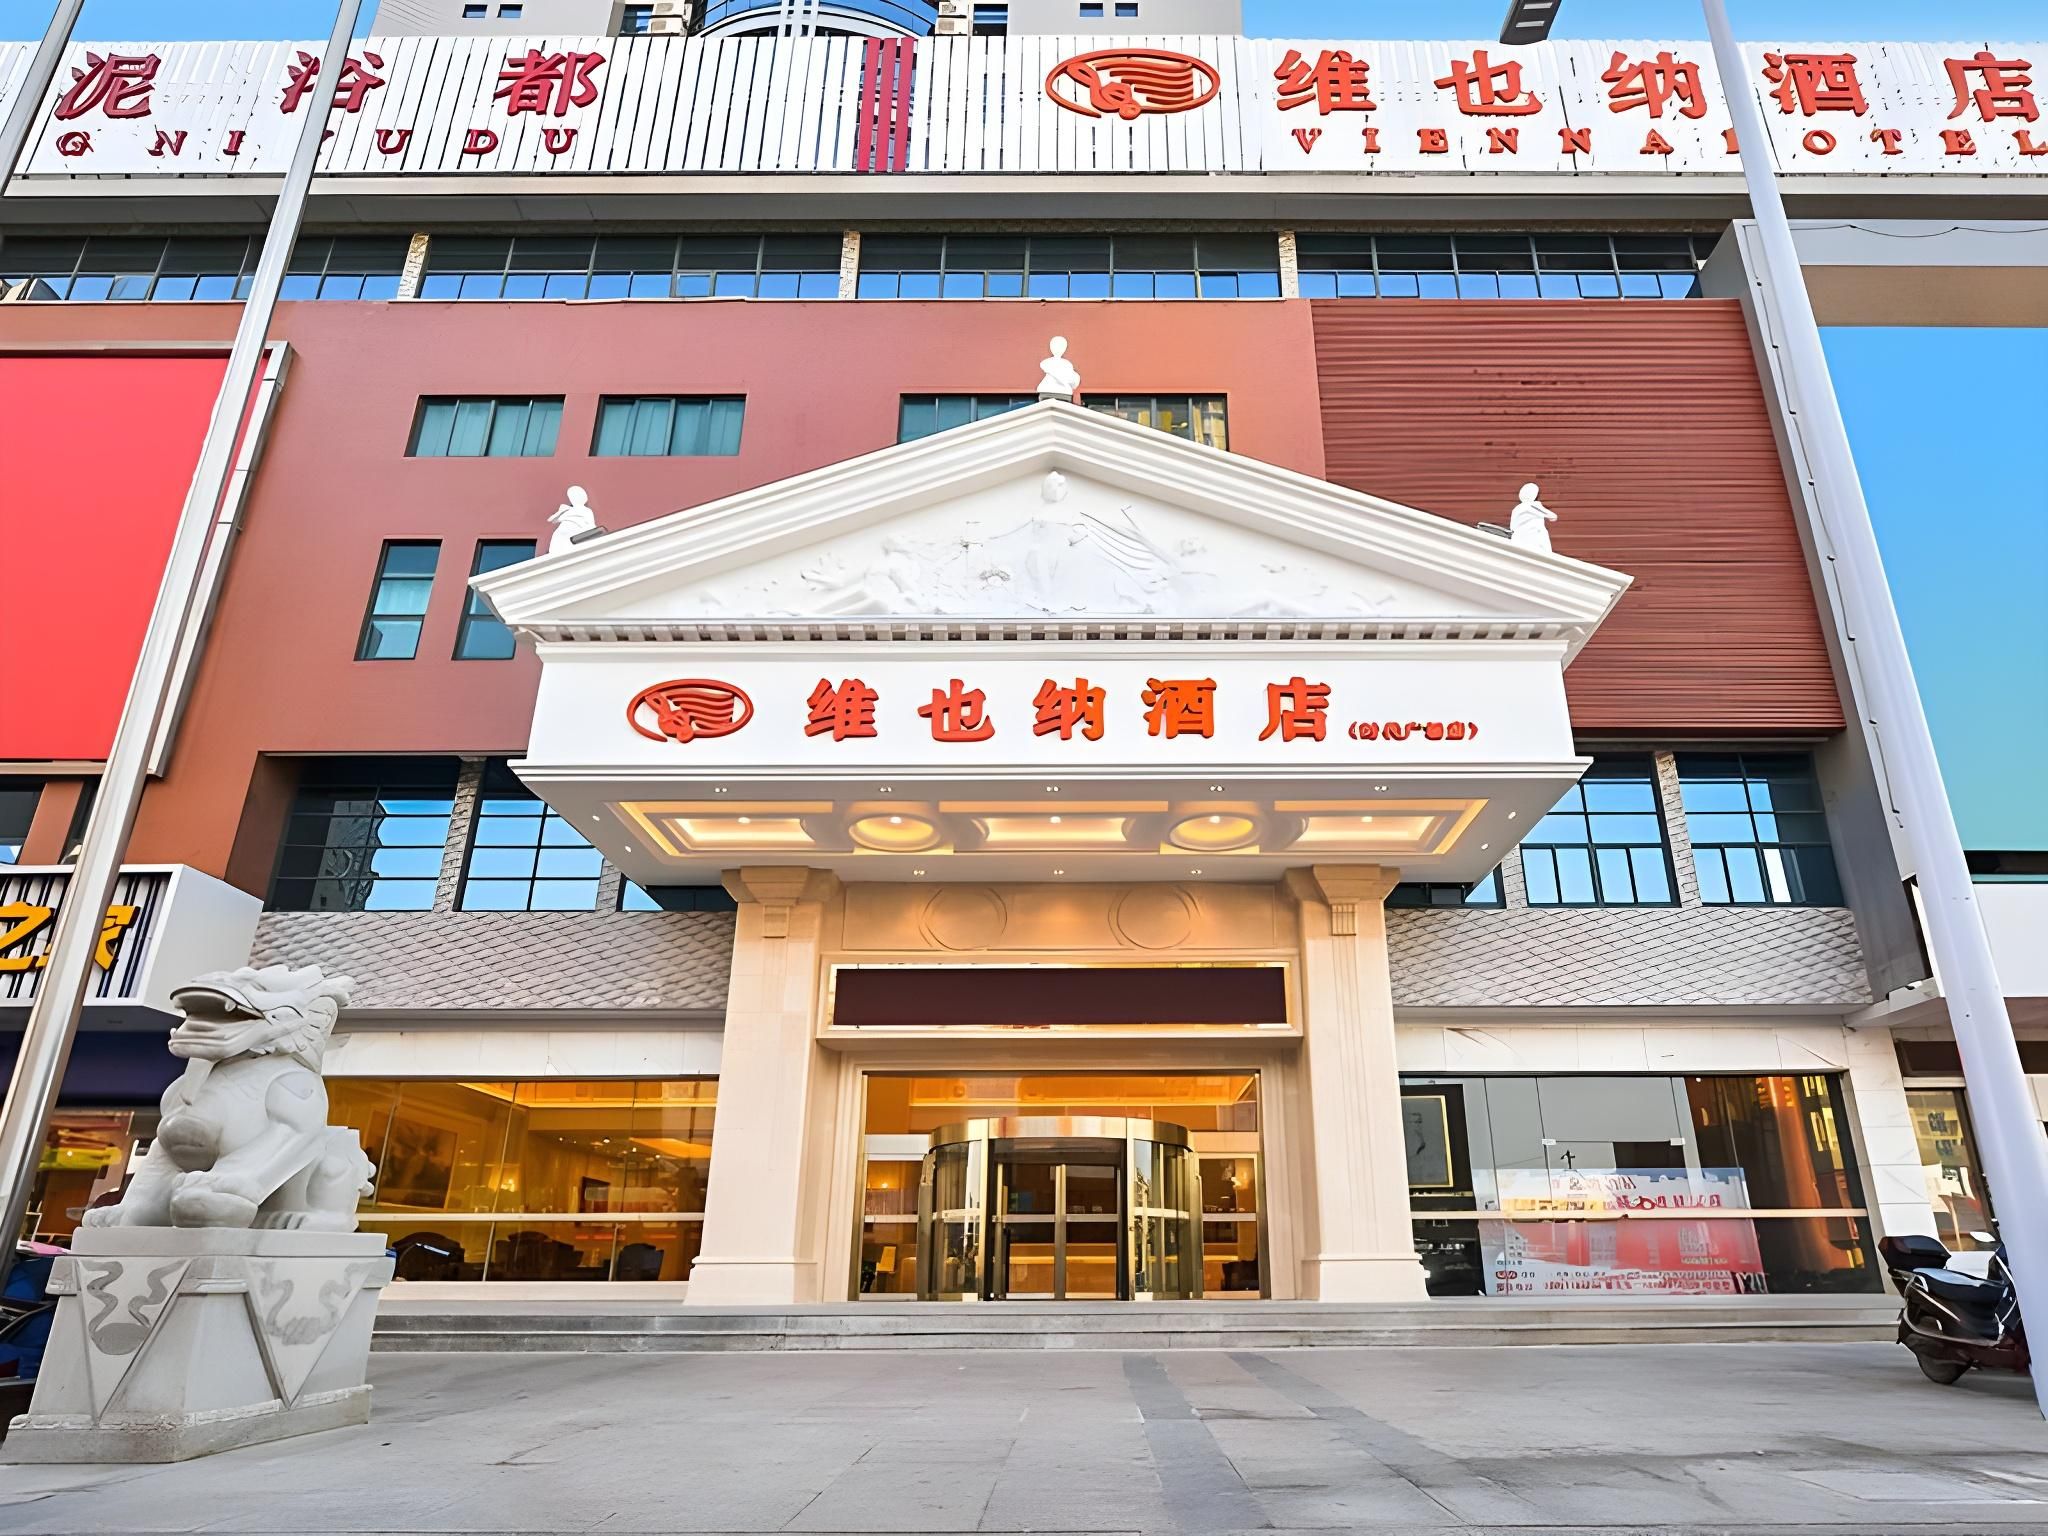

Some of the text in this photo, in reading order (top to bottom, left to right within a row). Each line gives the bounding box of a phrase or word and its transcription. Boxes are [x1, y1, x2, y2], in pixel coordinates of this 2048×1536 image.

[1274, 49, 2040, 123] 维也纳酒店
[1291, 127, 1674, 154] VIENNA
[803, 676, 1332, 743] 维也纳酒店
